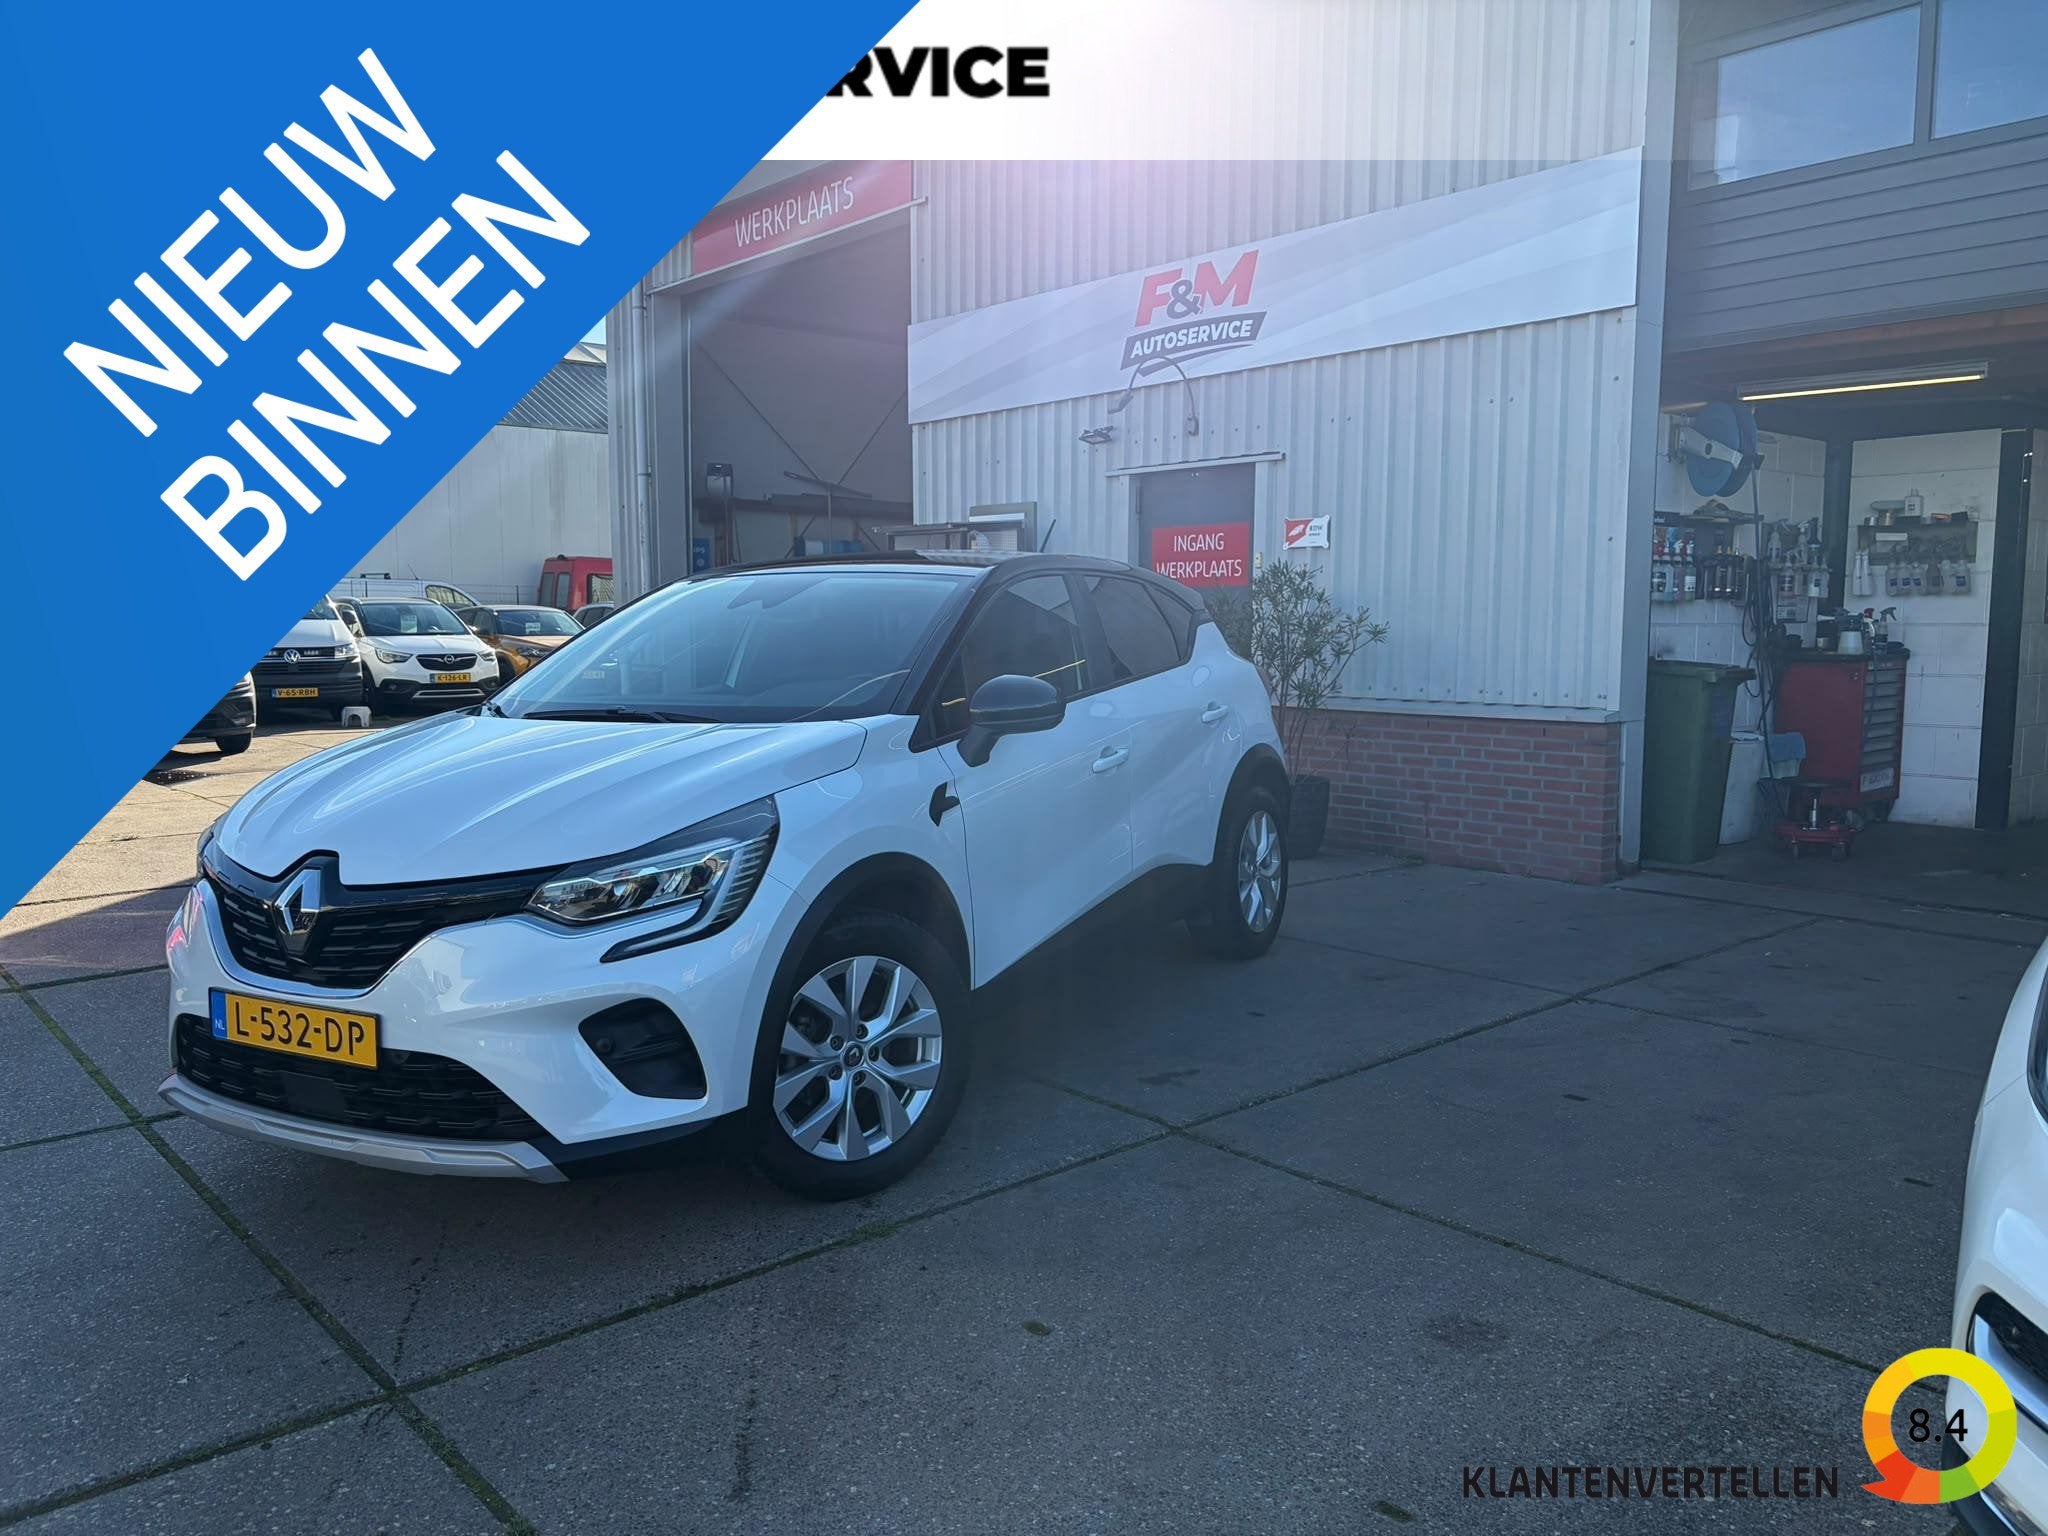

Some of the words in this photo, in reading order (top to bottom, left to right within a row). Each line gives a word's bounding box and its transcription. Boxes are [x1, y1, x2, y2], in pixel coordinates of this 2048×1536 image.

[735, 176, 854, 248] WERKPLAATS
[1135, 249, 1259, 328] F&M
[1130, 319, 1253, 359] AUTOSERVICE
[1173, 532, 1225, 552] INGANG
[1156, 559, 1242, 579] WERKPLAATS
[215, 1019, 225, 1030] NL
[235, 1001, 365, 1056] L-532-DP
